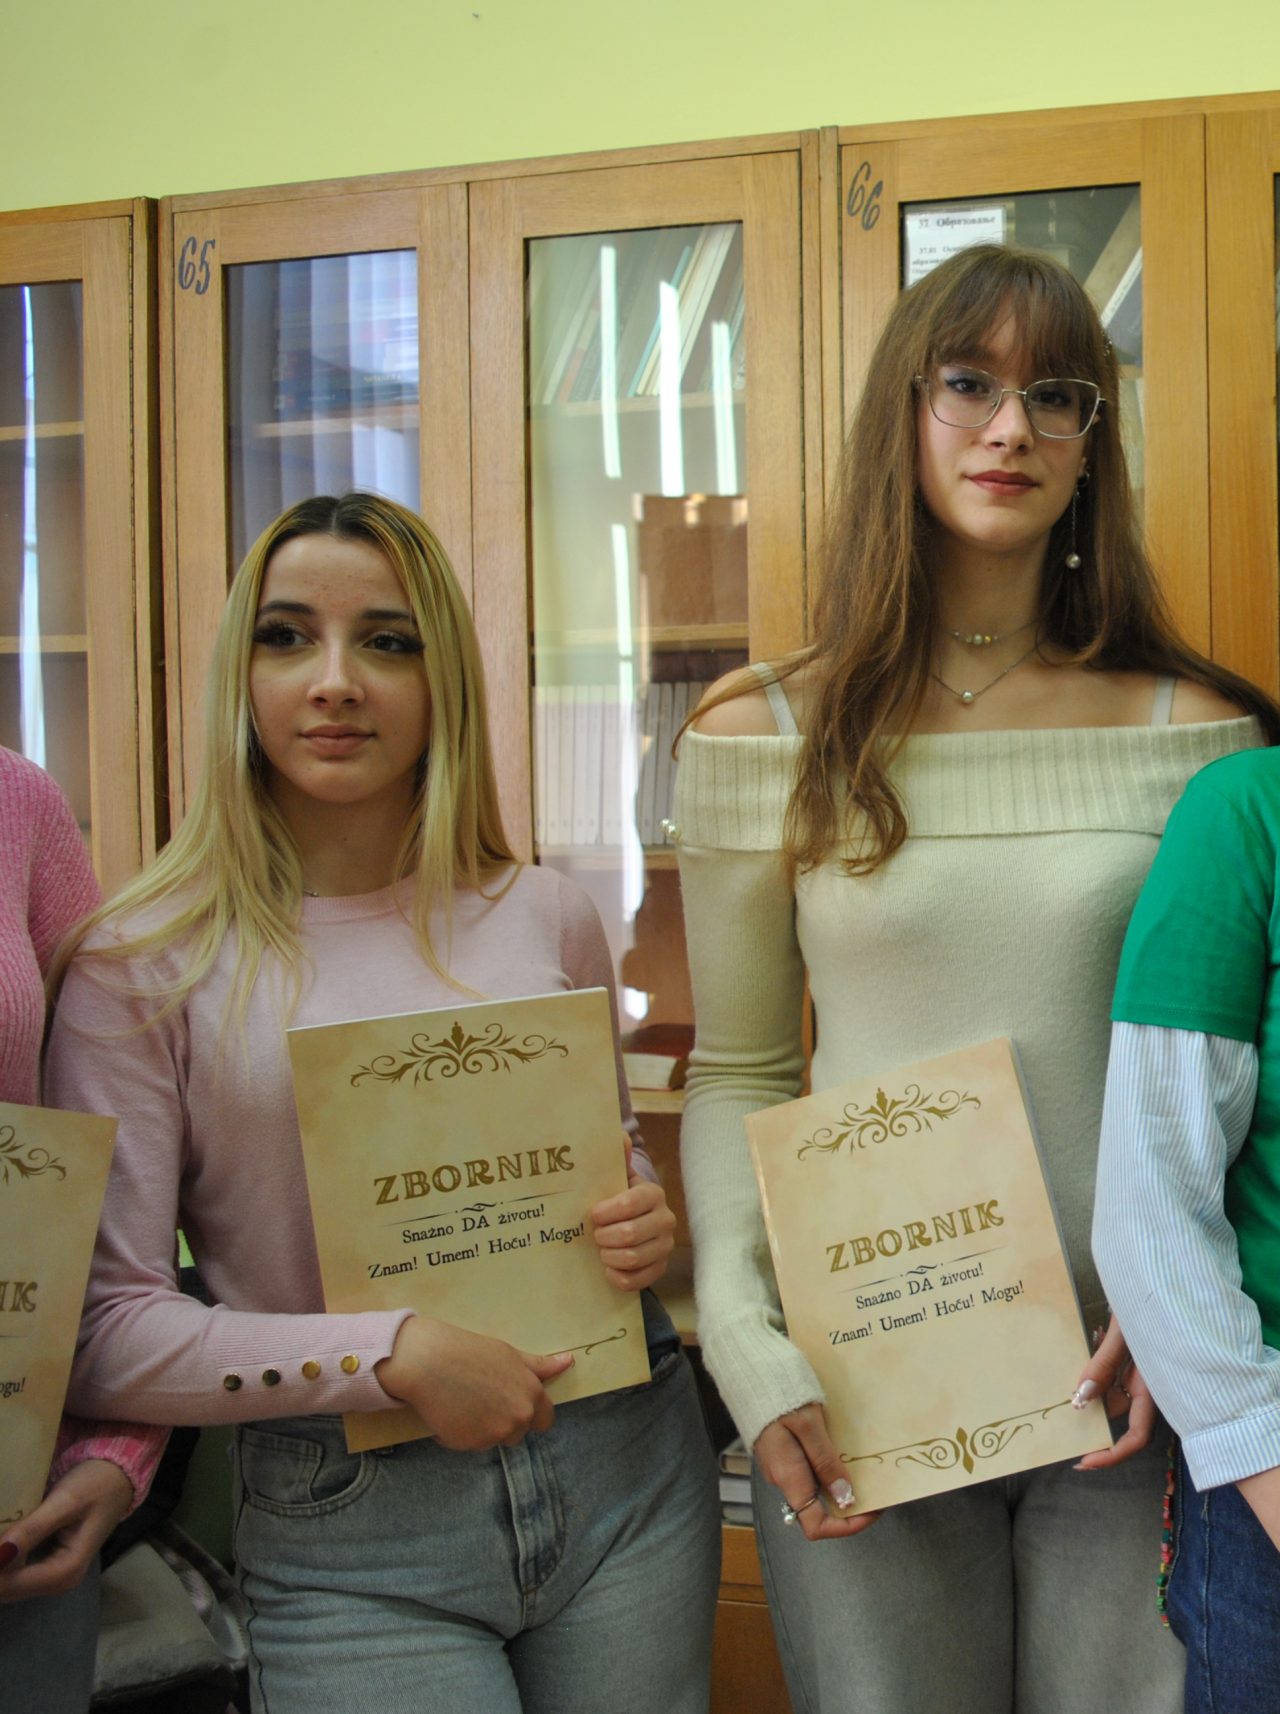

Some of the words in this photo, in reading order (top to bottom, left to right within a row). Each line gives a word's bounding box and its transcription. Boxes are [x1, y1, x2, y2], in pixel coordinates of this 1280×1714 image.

[847, 161, 883, 231] 66
[179, 236, 216, 295] 65
[373, 1145, 575, 1206] ZBORNIK
[368, 1256, 418, 1278] Znam!
[427, 1244, 479, 1266] Umem!
[488, 1233, 532, 1255] Hoću!
[540, 1222, 585, 1245] Mogu!
[402, 1222, 454, 1244] Snažno
[462, 1215, 490, 1233] DA
[498, 1203, 545, 1225] životu!
[826, 1199, 1004, 1273] ZBORNIK
[829, 1321, 873, 1346] Znam!
[879, 1306, 928, 1331] Umem!
[934, 1294, 975, 1318] Hoću!
[981, 1280, 1025, 1304] Mogu!
[855, 1287, 901, 1310] Snažno
[908, 1276, 934, 1296] DA
[940, 1262, 984, 1287] životu!
[0, 1376, 26, 1399] ogu!
